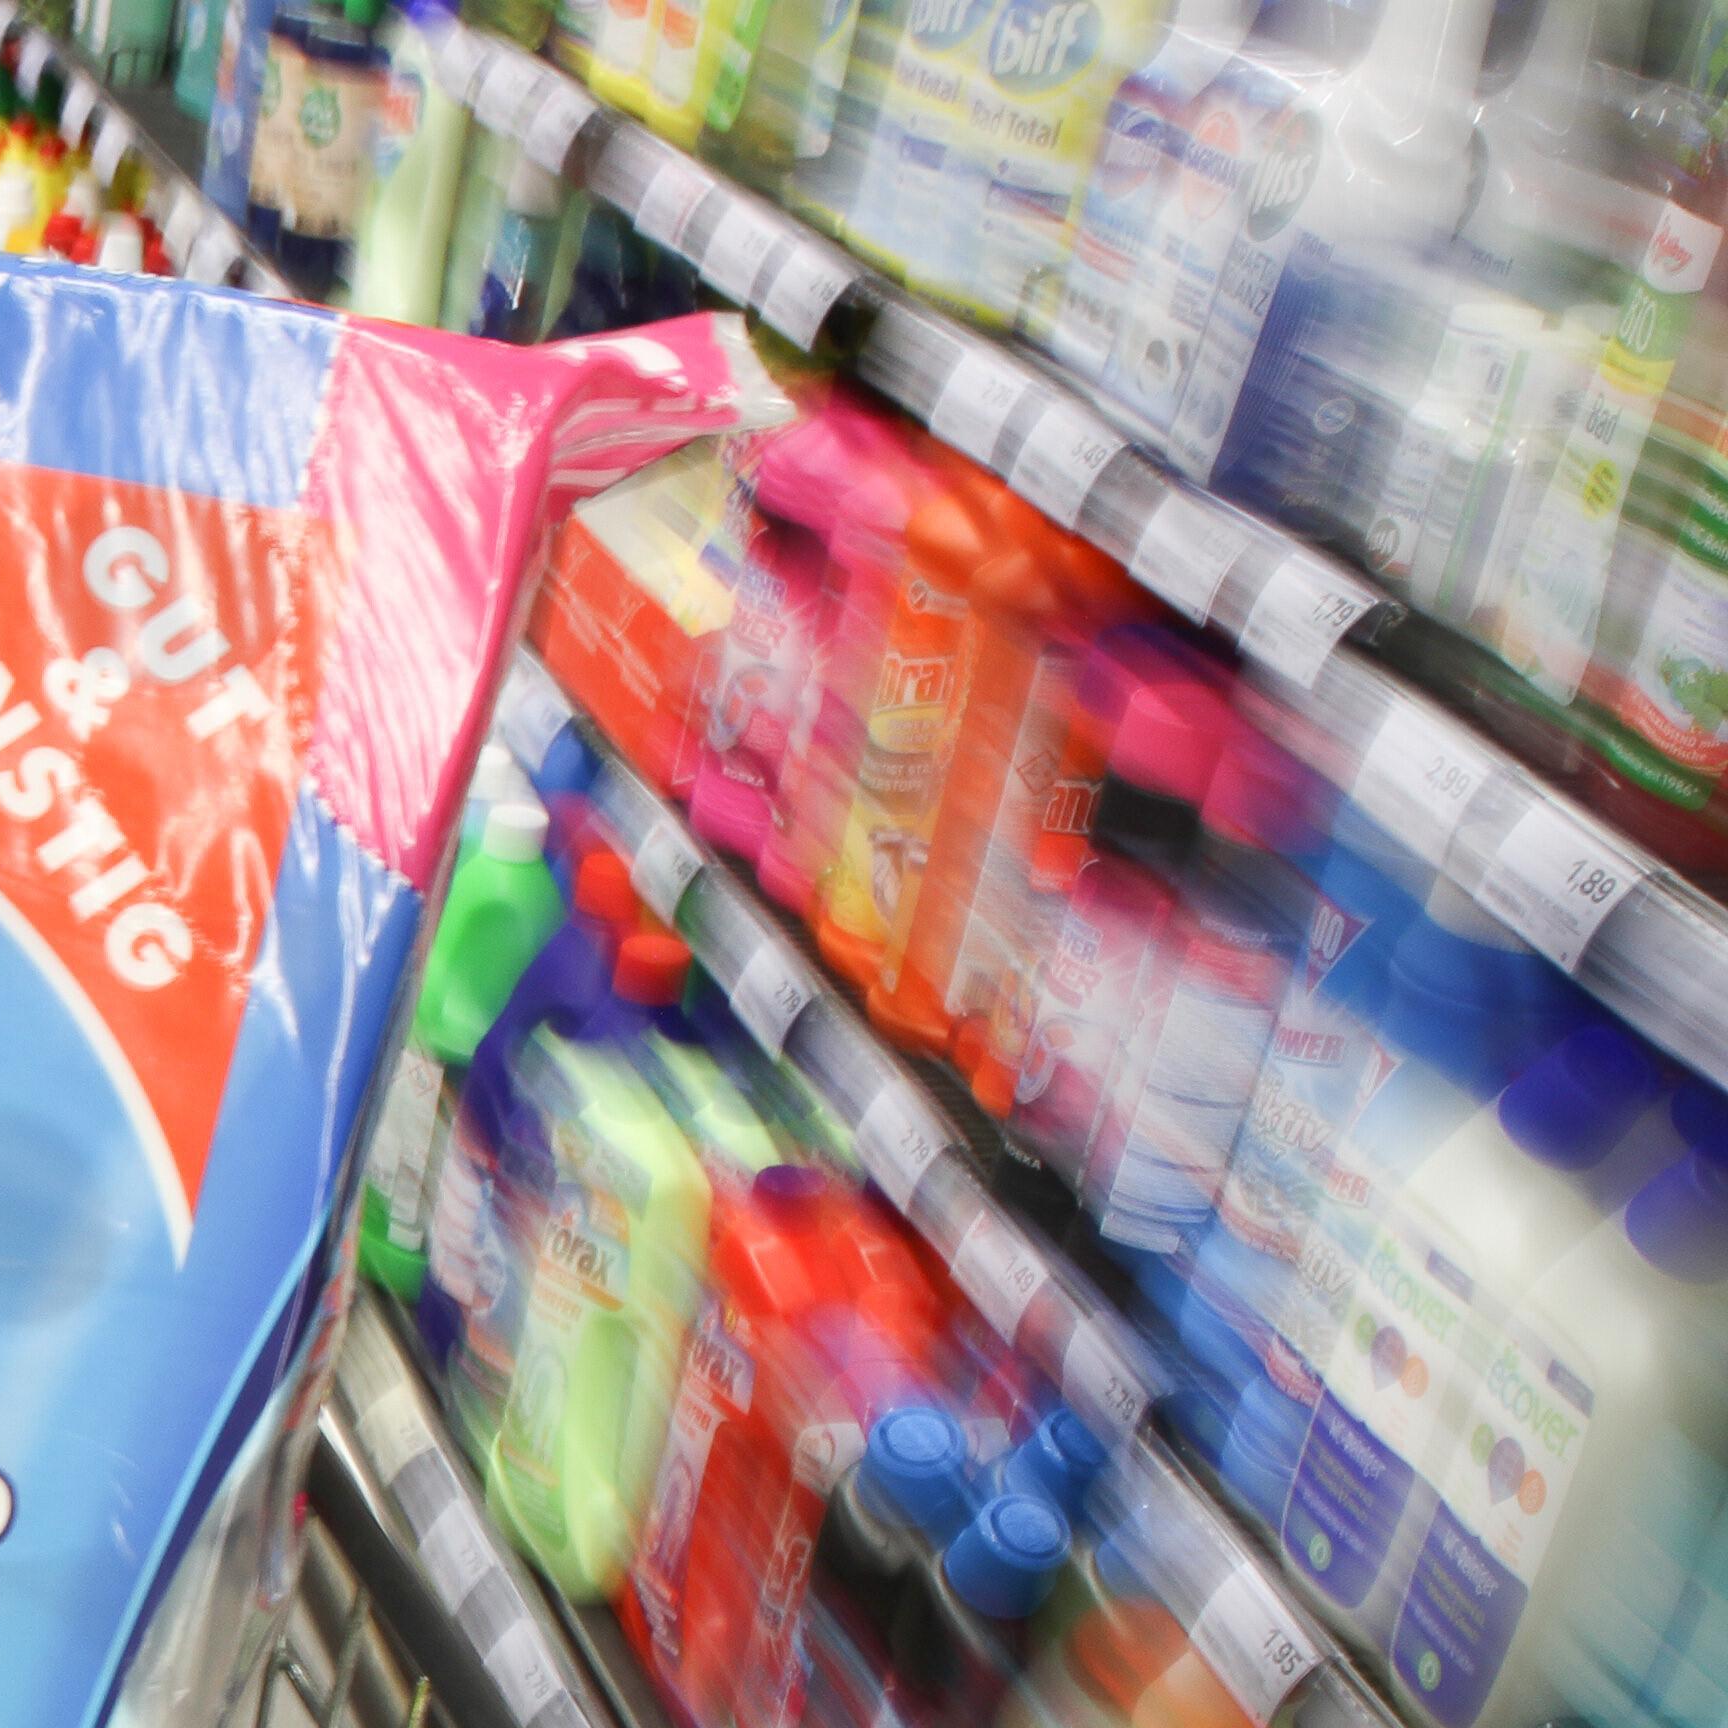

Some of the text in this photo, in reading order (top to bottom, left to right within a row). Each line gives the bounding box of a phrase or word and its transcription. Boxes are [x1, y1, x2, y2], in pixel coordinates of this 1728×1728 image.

[993, 3, 1089, 76] biff
[1006, 111, 1065, 150] Total
[83, 526, 277, 742] GUT
[1312, 592, 1355, 629] 1,79
[43, 646, 130, 741] &
[1424, 754, 1471, 801] 2,99
[1566, 858, 1617, 904] 1,89
[899, 1126, 931, 1163] 2,79
[1005, 1256, 1036, 1295] 1,49
[1105, 1375, 1137, 1422] 2,79
[1487, 1359, 1581, 1460] ecover
[1263, 1629, 1304, 1676] 1,95
